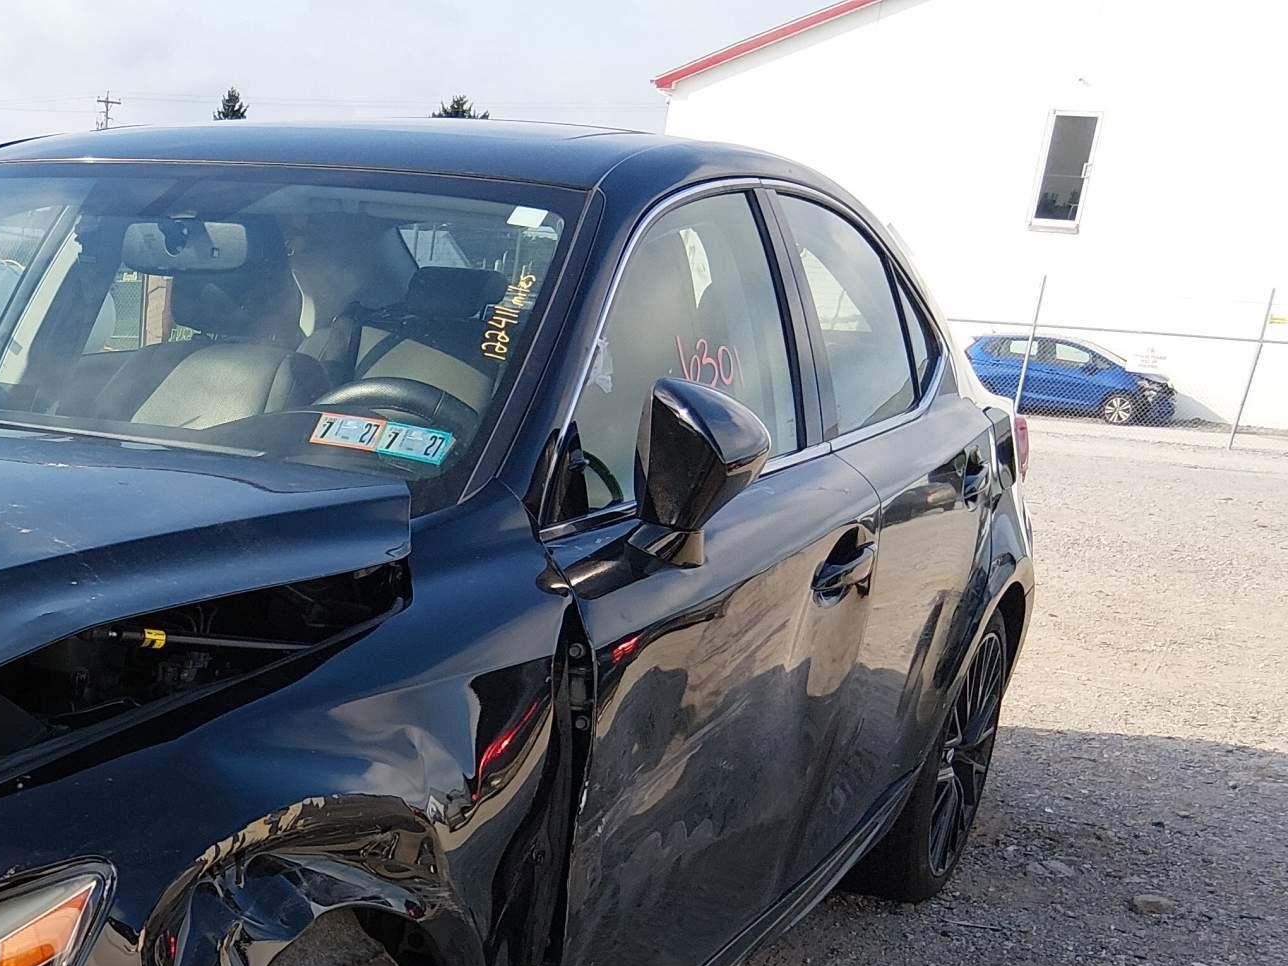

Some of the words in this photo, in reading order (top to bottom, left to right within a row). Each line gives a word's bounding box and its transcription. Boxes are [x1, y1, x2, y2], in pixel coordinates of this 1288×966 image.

[481, 304, 520, 360] 122411
[359, 422, 381, 445] 27
[423, 434, 446, 458] 27
